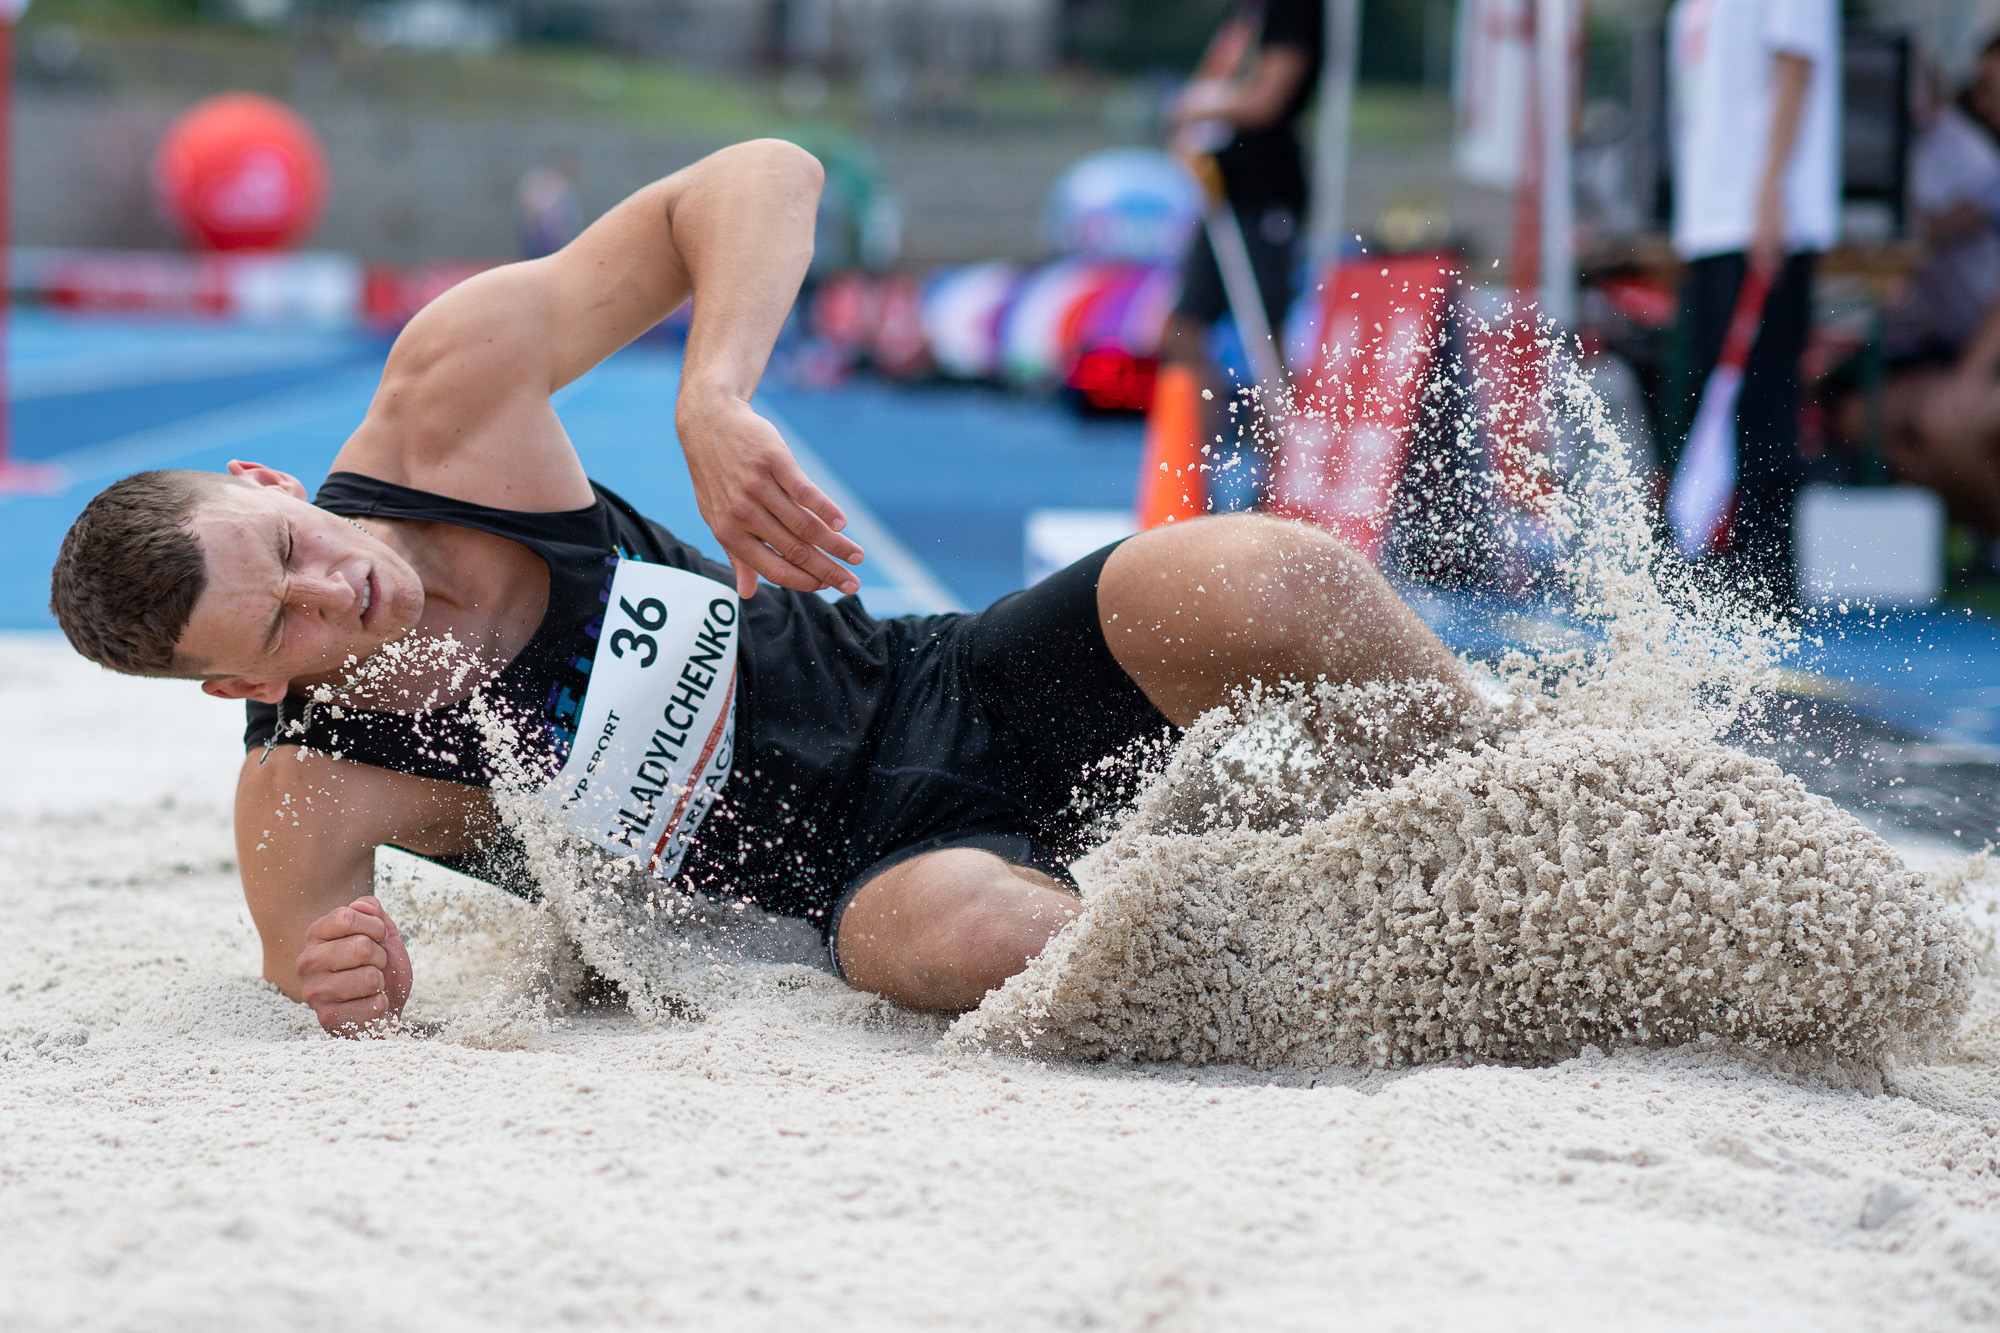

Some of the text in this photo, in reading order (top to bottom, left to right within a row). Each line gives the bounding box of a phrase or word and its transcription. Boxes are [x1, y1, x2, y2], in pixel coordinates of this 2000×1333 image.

[610, 595, 668, 669] 36
[561, 777, 588, 810] VP
[586, 709, 620, 775] SPORT
[607, 598, 736, 850] HLADYLCHENKO
